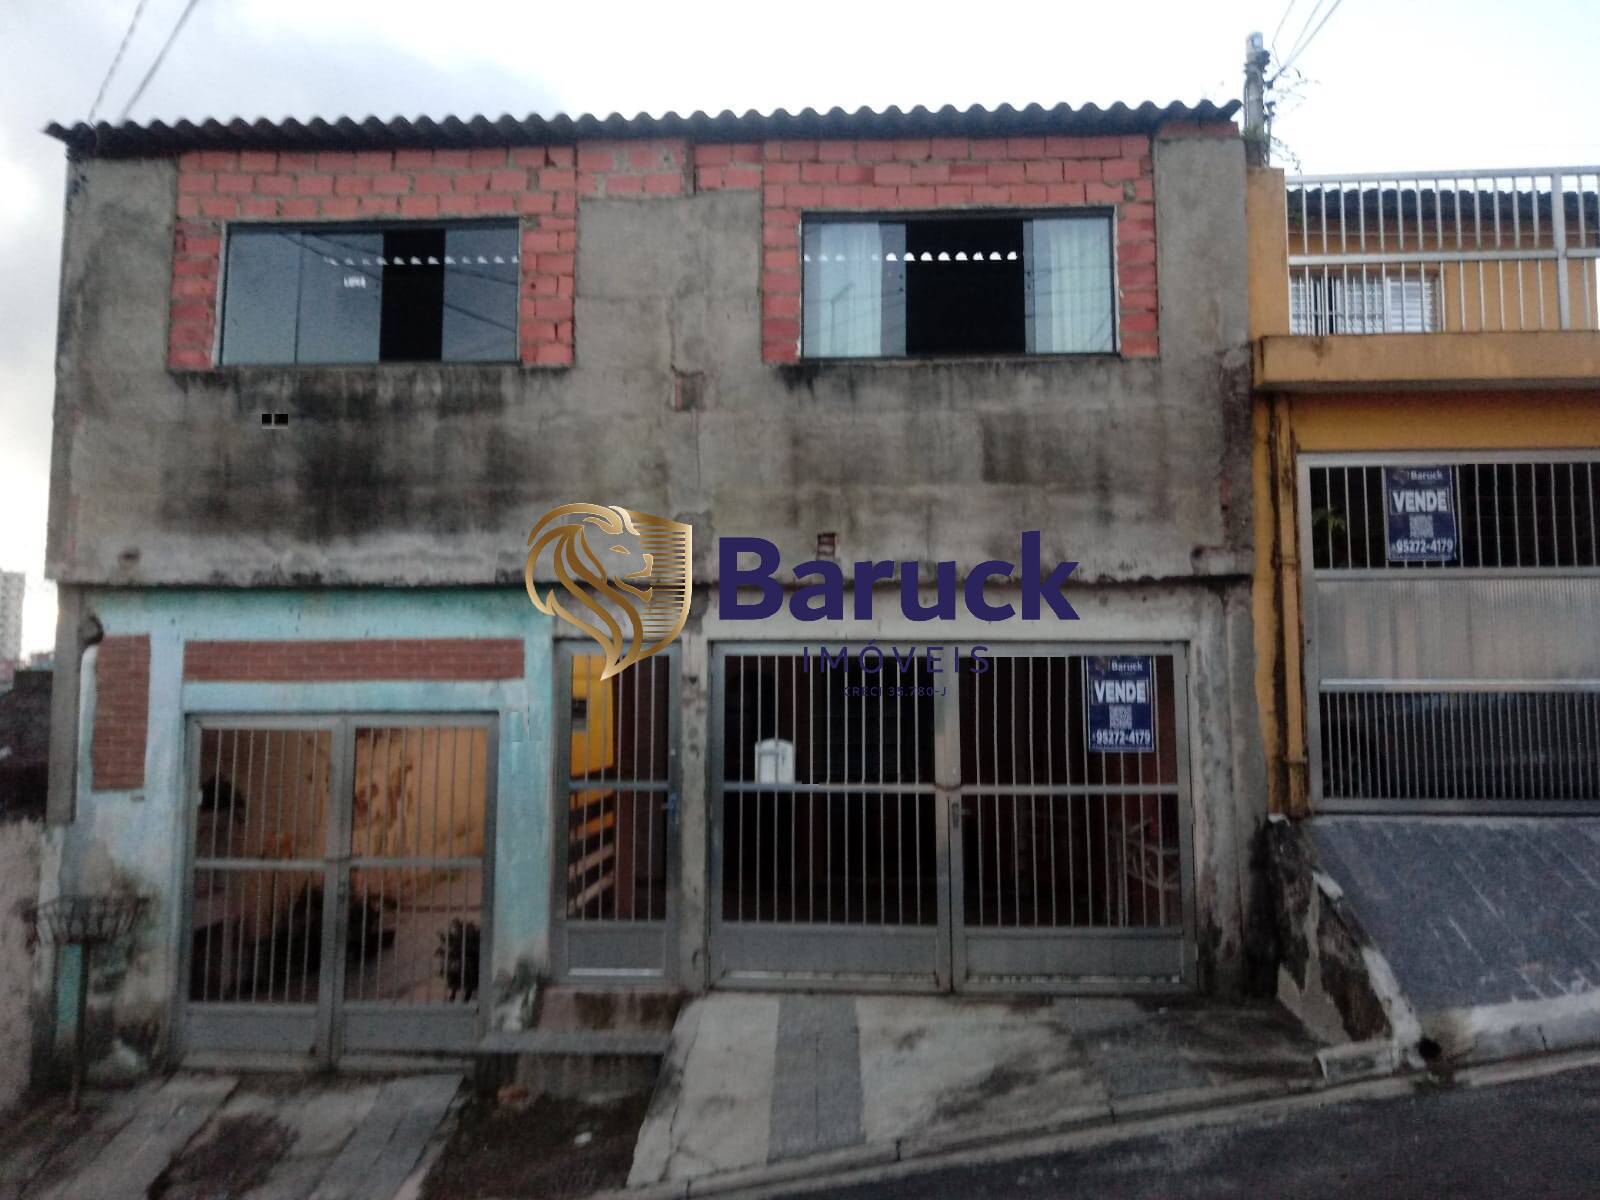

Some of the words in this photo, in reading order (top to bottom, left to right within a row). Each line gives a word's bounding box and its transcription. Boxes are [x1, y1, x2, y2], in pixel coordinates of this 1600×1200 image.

[1392, 490, 1447, 512] VENDE
[1396, 538, 1453, 554] 95272-4179
[1111, 661, 1143, 672] Baruck
[1094, 680, 1146, 703] VENDE
